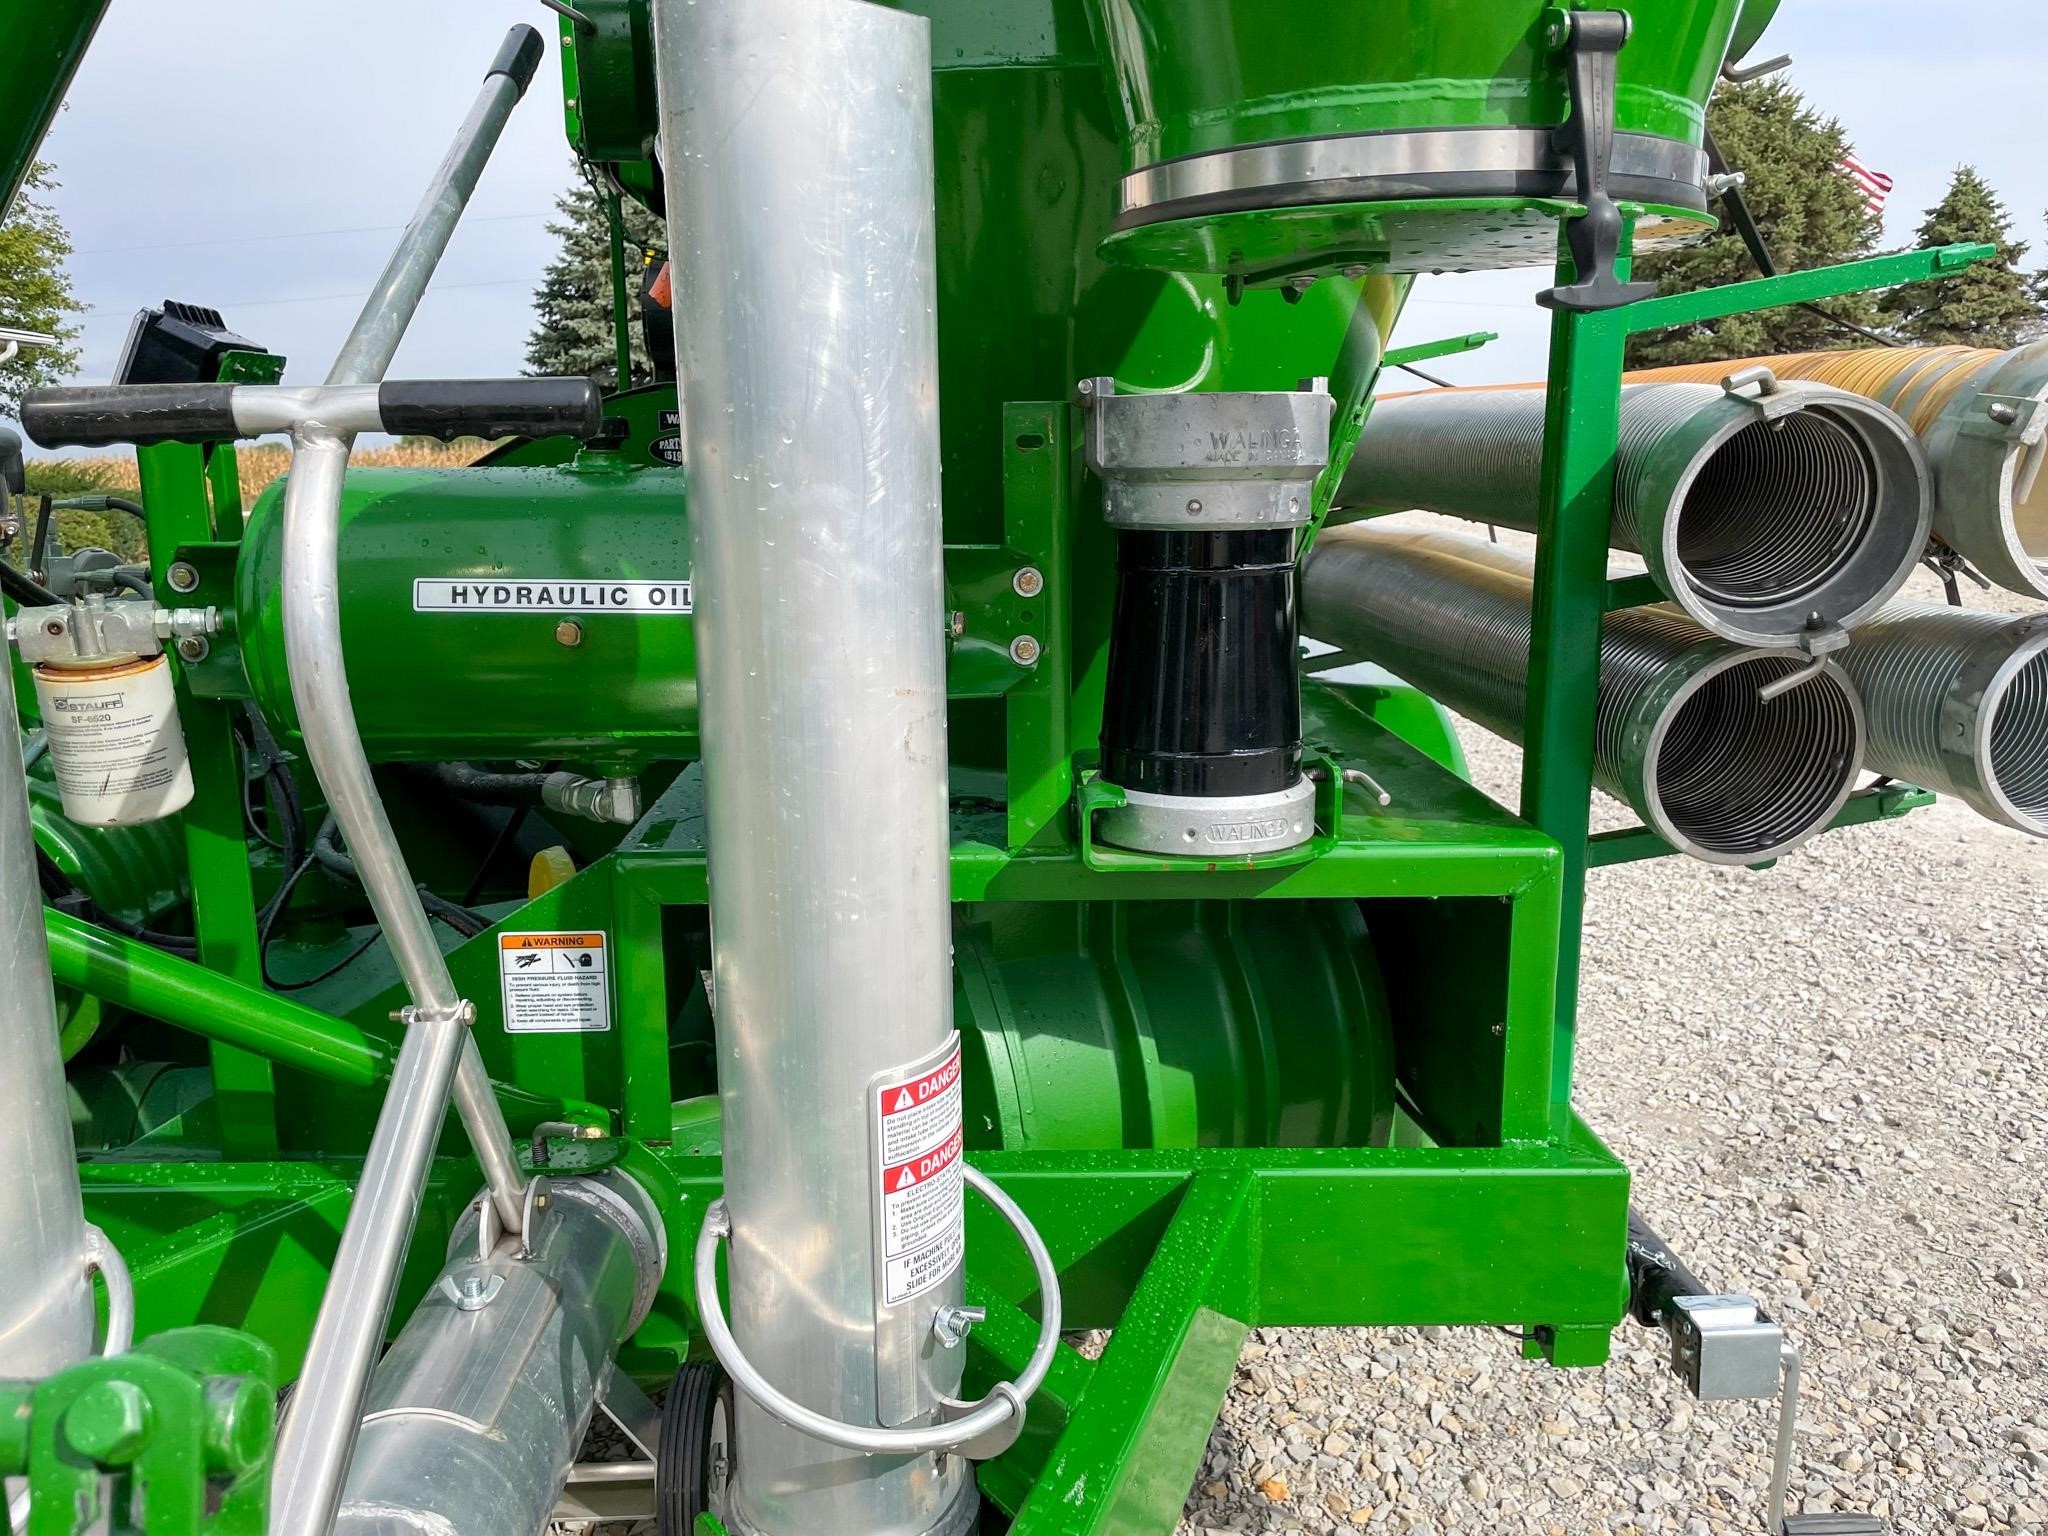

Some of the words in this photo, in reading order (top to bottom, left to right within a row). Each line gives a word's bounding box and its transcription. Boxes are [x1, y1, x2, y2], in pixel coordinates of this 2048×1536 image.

[1209, 427, 1303, 450] WALINGA
[451, 585, 628, 606] HYDRAULIC
[649, 587, 691, 606] OIL
[68, 699, 122, 711] STAUFF
[1209, 820, 1286, 842] WALINGA
[534, 937, 584, 946] WARNING
[919, 1055, 961, 1100] DANGER
[907, 1109, 922, 1120] place
[887, 1120, 913, 1132] standing
[887, 1128, 911, 1138] material
[887, 1138, 899, 1146] and
[900, 1132, 917, 1142] intake
[888, 1138, 921, 1153] Submersion
[921, 1130, 962, 1177] DANGER
[900, 1194, 921, 1207] prevent
[900, 1205, 915, 1214] Make
[900, 1213, 913, 1221] area
[900, 1220, 912, 1228] Use
[910, 1223, 919, 1231] not
[903, 1258, 911, 1269] IF
[913, 1240, 943, 1265] MACHINE
[910, 1246, 950, 1278] EXCESSIVELY
[906, 1274, 928, 1291] SLIDE
[928, 1265, 941, 1280] FOR
